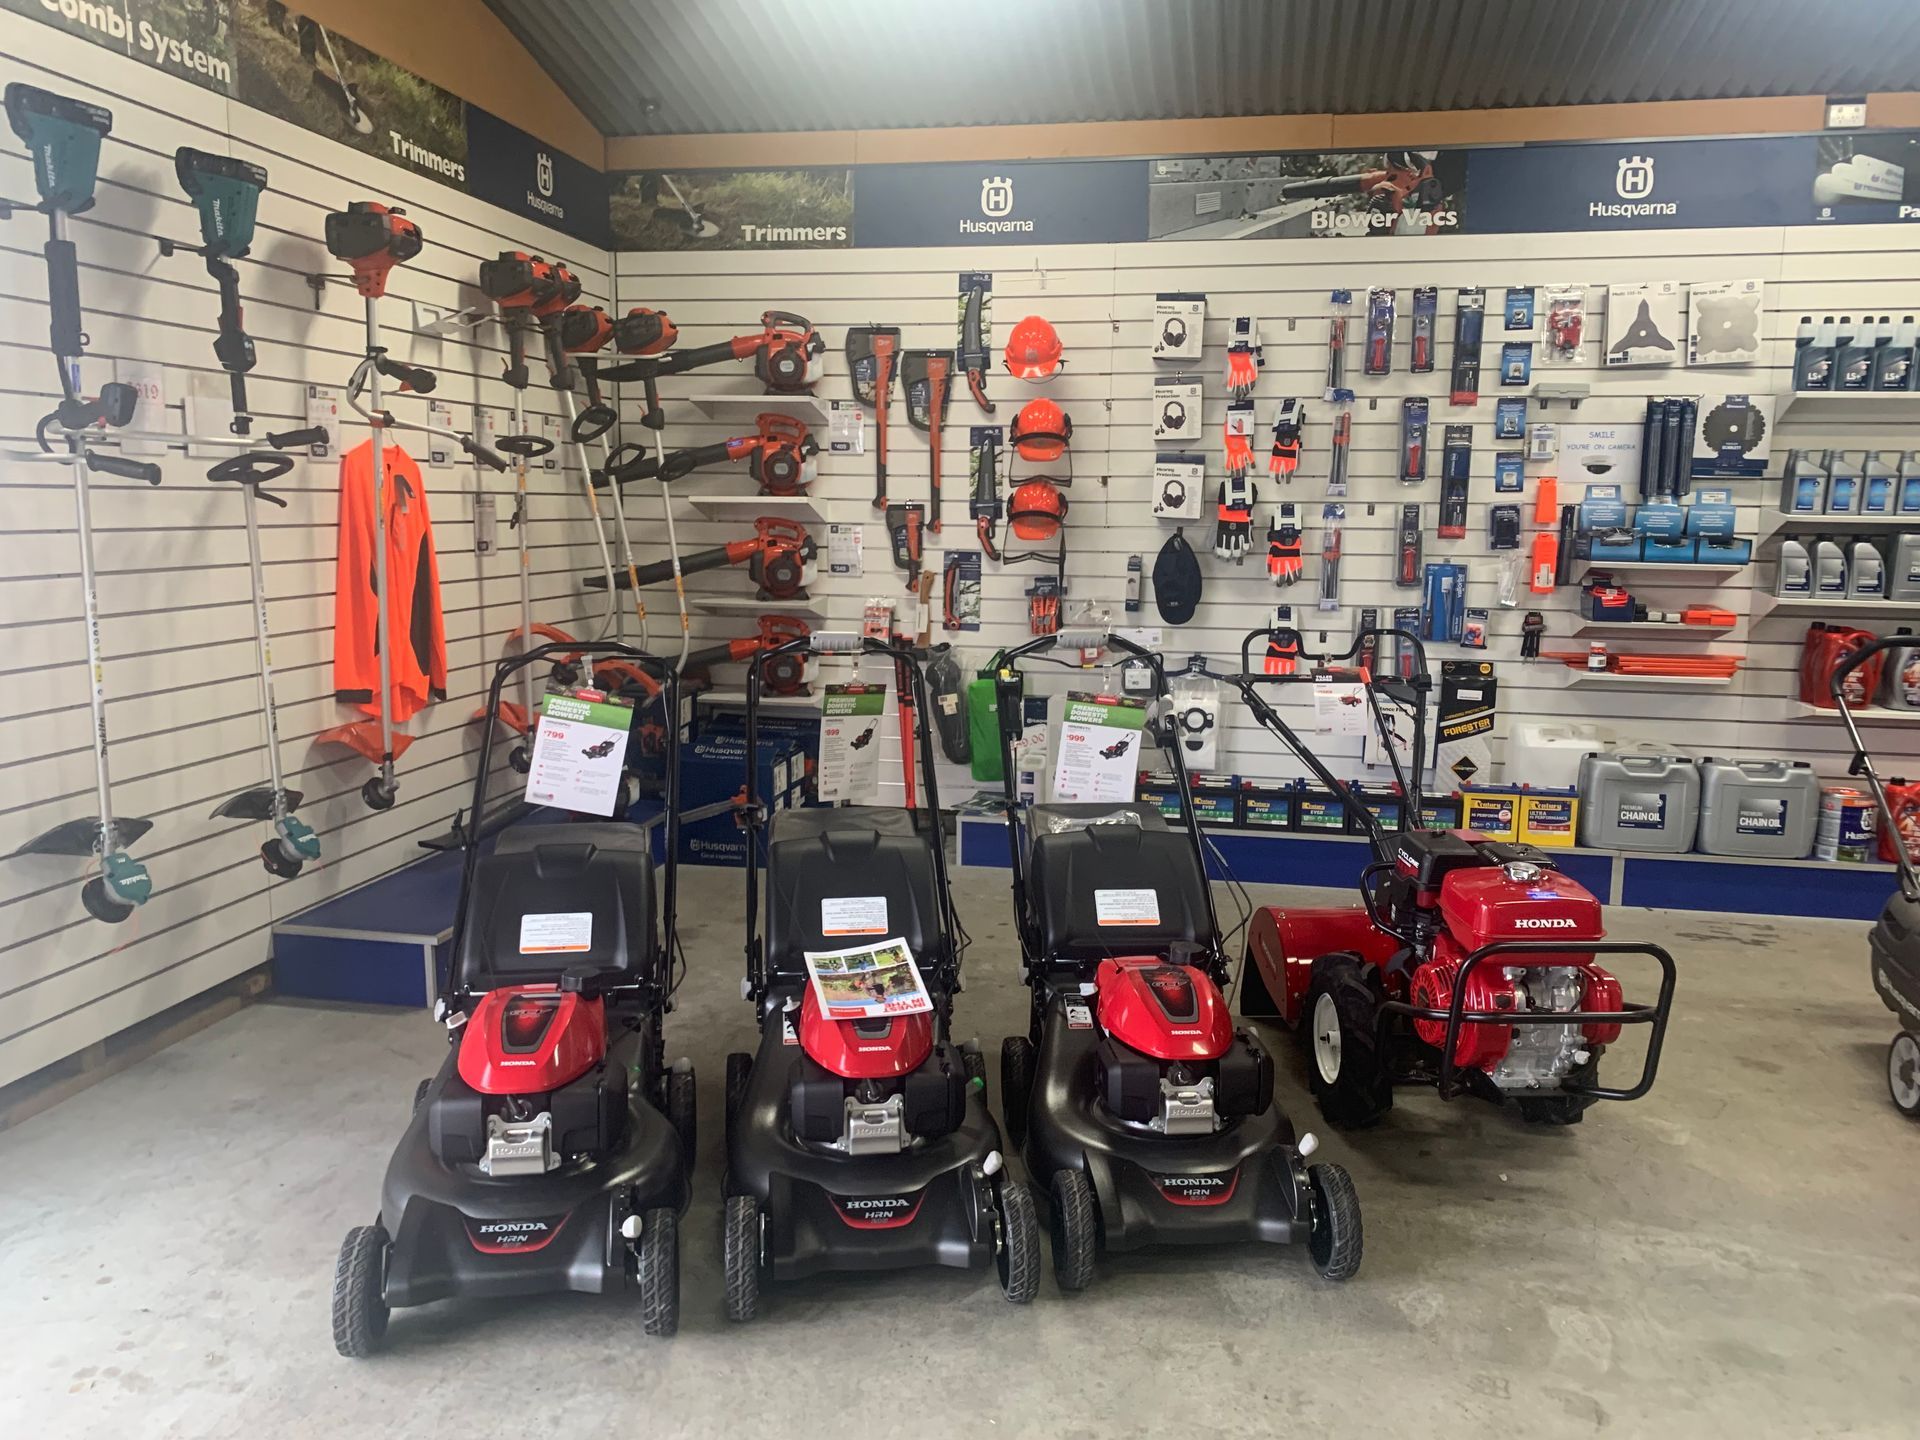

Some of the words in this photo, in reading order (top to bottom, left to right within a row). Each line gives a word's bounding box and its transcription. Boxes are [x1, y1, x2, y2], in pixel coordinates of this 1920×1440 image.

[139, 21, 231, 83] System
[390, 131, 465, 182] Trimmers
[527, 191, 564, 219] Husqvarna
[1589, 201, 1677, 219] Husqvarna
[213, 199, 223, 237] makita
[1311, 210, 1399, 229] Blower
[1402, 208, 1458, 227] Vacs
[959, 219, 1034, 235] Husqvarna
[741, 224, 846, 242] Trimmers
[551, 698, 591, 709] PREMIUM
[1072, 704, 1108, 713] PREMIUM
[547, 709, 585, 720] MOWERS
[548, 703, 592, 716] DOMESTIC
[1071, 710, 1109, 719] DOMESTIC
[1070, 715, 1103, 723] MOWERS
[1444, 718, 1491, 737] FORESTER
[544, 730, 564, 739] $799
[1066, 734, 1085, 742] $999
[1620, 811, 1648, 820] CHAIN
[1649, 812, 1662, 821] OIL
[1739, 817, 1767, 826] CHAIN
[1768, 818, 1782, 827] OIL
[1398, 848, 1420, 868] CYCLONE
[1514, 919, 1577, 928] HONDA
[1164, 1178, 1224, 1186] HONDA
[846, 1199, 910, 1209] HONDA
[480, 1222, 548, 1233] HONDA
[497, 1235, 528, 1243] HRN
